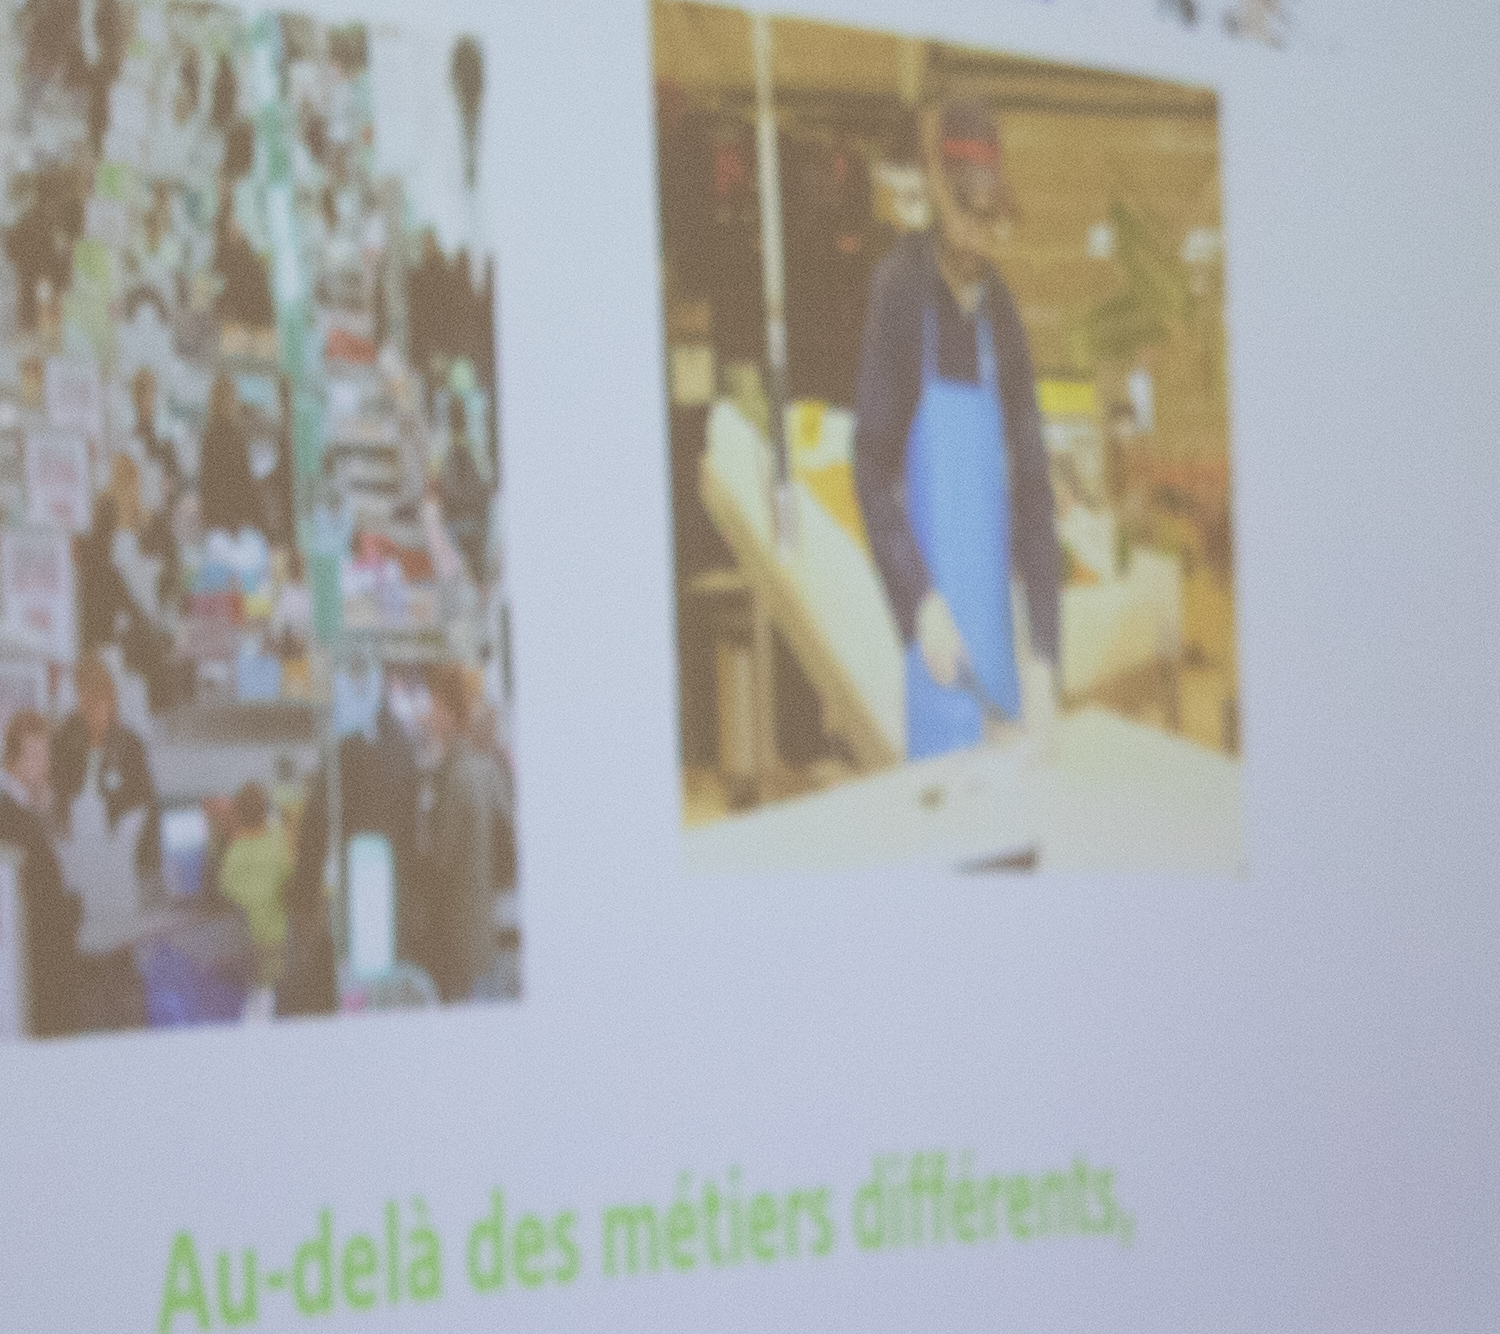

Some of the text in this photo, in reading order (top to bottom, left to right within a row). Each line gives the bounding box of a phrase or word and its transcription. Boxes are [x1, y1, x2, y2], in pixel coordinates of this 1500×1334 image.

[465, 1187, 583, 1295] des
[601, 1167, 837, 1279] métiers
[853, 1149, 1138, 1251] différents,
